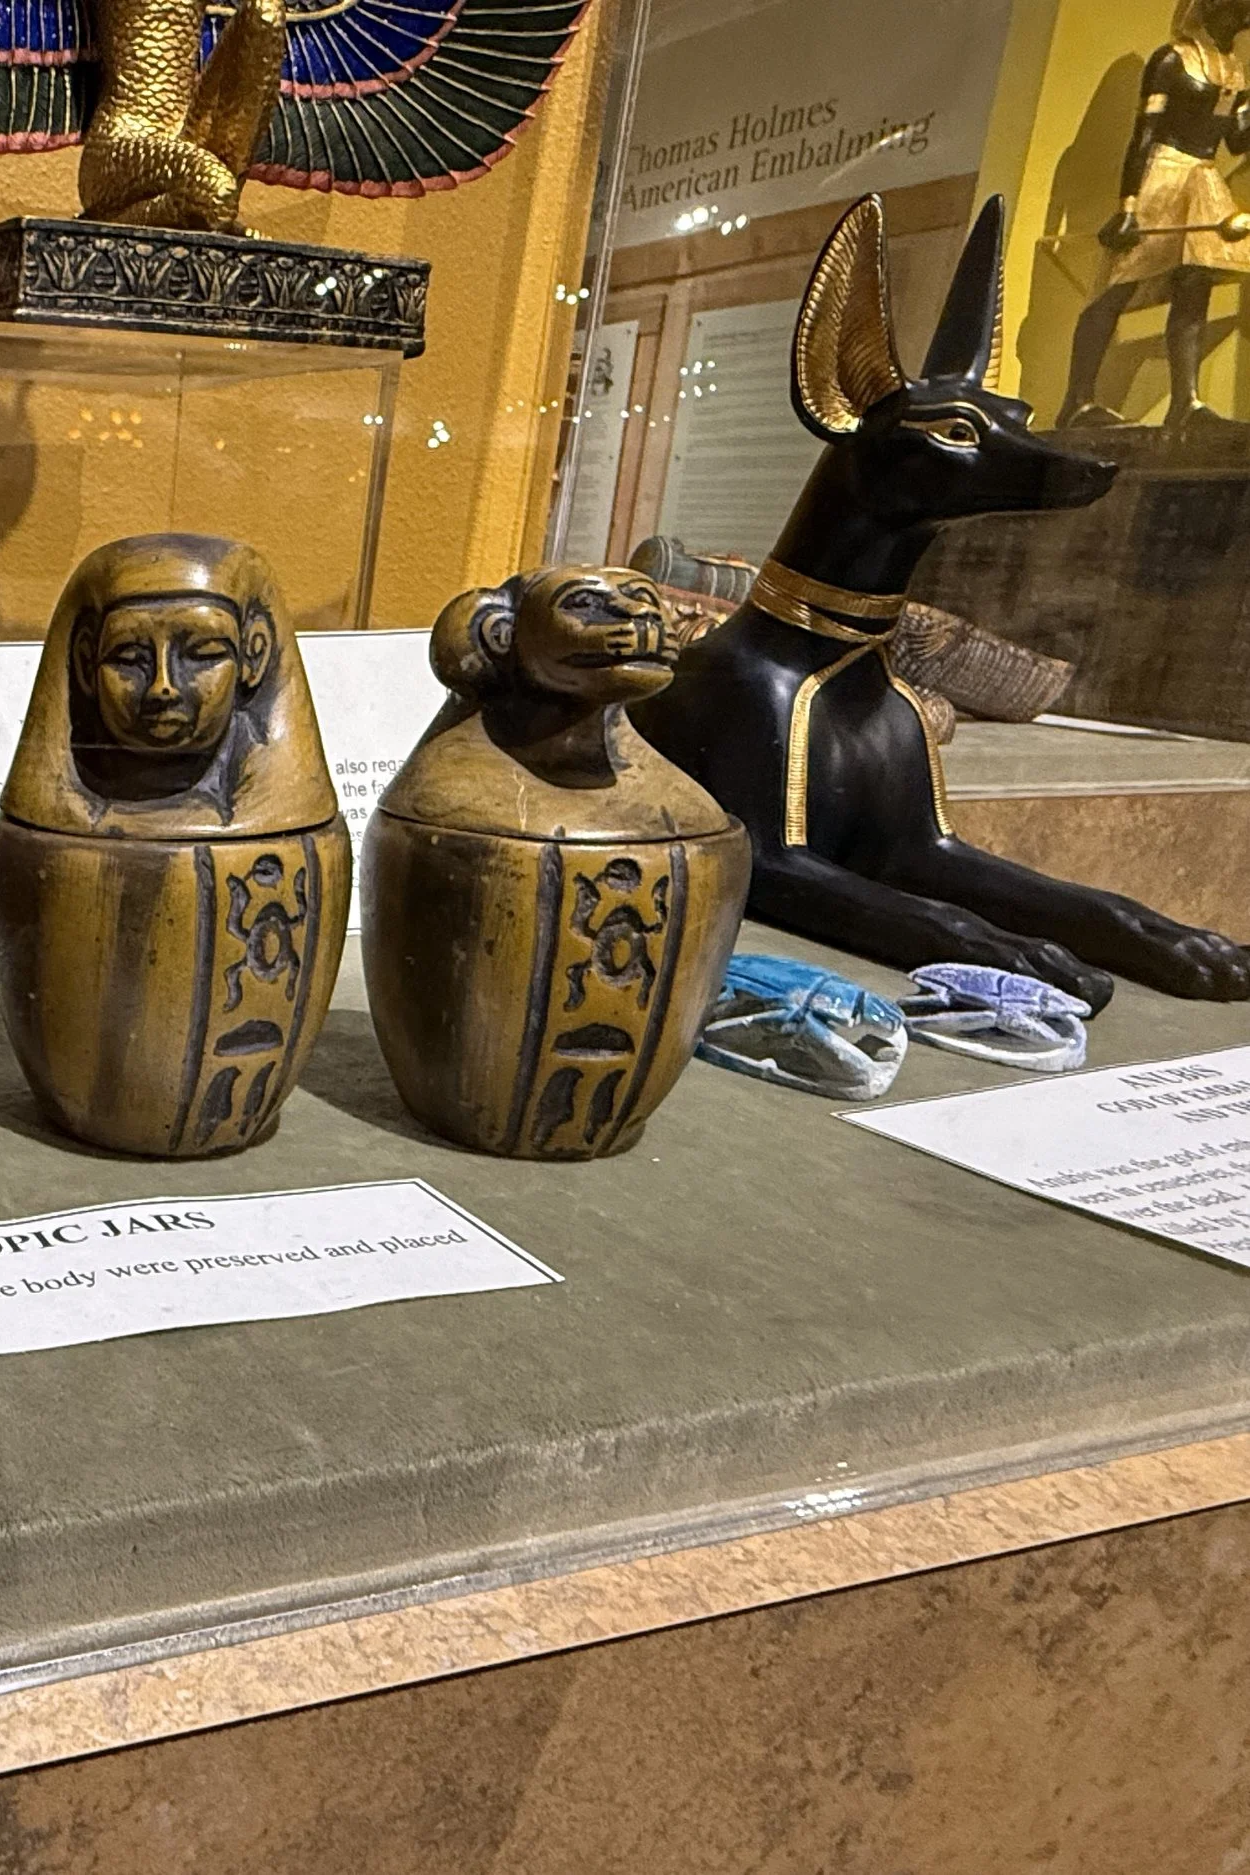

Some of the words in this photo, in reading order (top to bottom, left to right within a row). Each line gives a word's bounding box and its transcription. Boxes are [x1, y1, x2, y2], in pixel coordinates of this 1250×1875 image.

[727, 98, 839, 150] Holmes
[622, 164, 740, 212] American
[751, 111, 936, 182] Embalming
[336, 758, 368, 775] also
[342, 781, 367, 797] the
[1117, 1064, 1223, 1090] ANUBIS
[1096, 1098, 1158, 1113] GOD
[1149, 1092, 1190, 1106] OF
[1173, 1108, 1230, 1123] AND
[1216, 1100, 1250, 1115] TH
[1026, 1169, 1103, 1189] Anubis
[1163, 1148, 1206, 1167] god
[101, 1210, 216, 1239] JARS
[21, 1267, 97, 1295] body
[105, 1258, 180, 1280] were
[184, 1244, 321, 1275] preserved
[325, 1238, 376, 1258] and
[378, 1227, 469, 1252] placed
